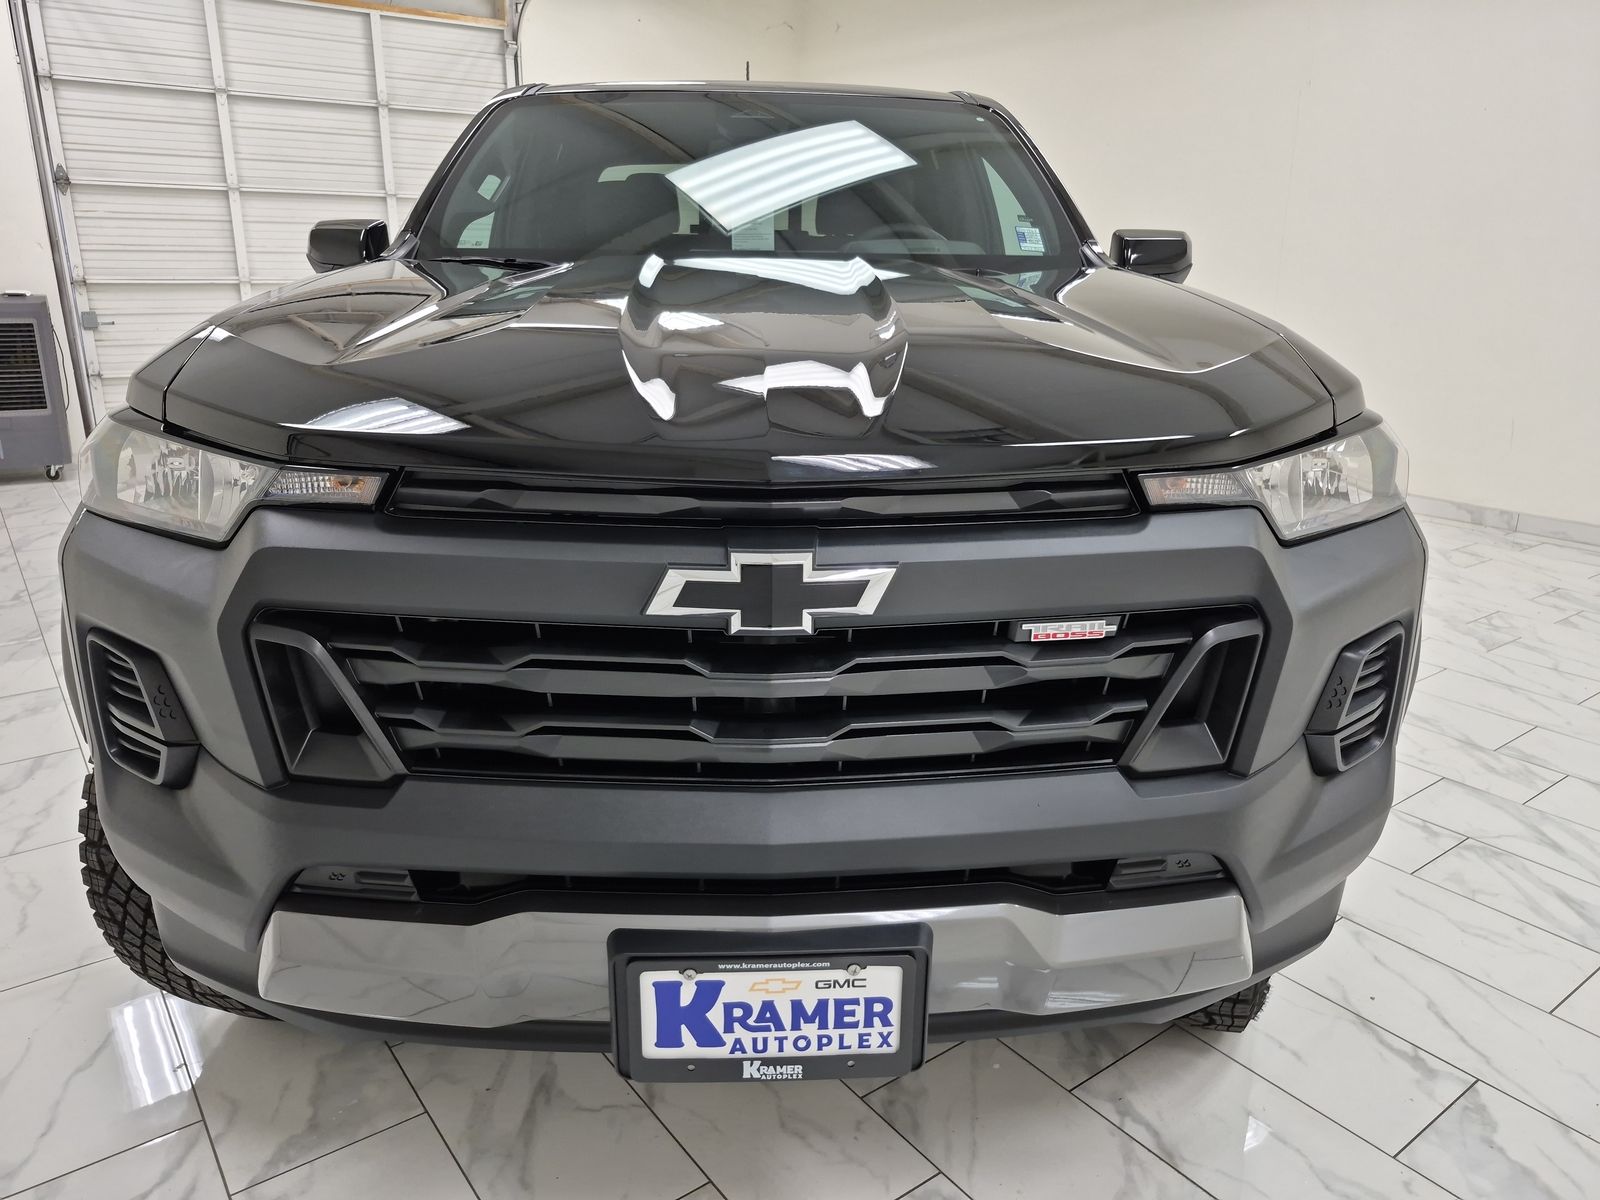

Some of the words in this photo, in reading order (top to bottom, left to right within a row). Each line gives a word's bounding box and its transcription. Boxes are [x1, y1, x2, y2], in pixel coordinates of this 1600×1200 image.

[1033, 630, 1104, 640] BOSS
[718, 962, 831, 970] www.kramerautoplex.com
[815, 978, 867, 990] GMC
[652, 979, 895, 1049] KRAMER
[728, 1031, 895, 1056] AUTOPLEX
[742, 1060, 803, 1079] KRAMER
